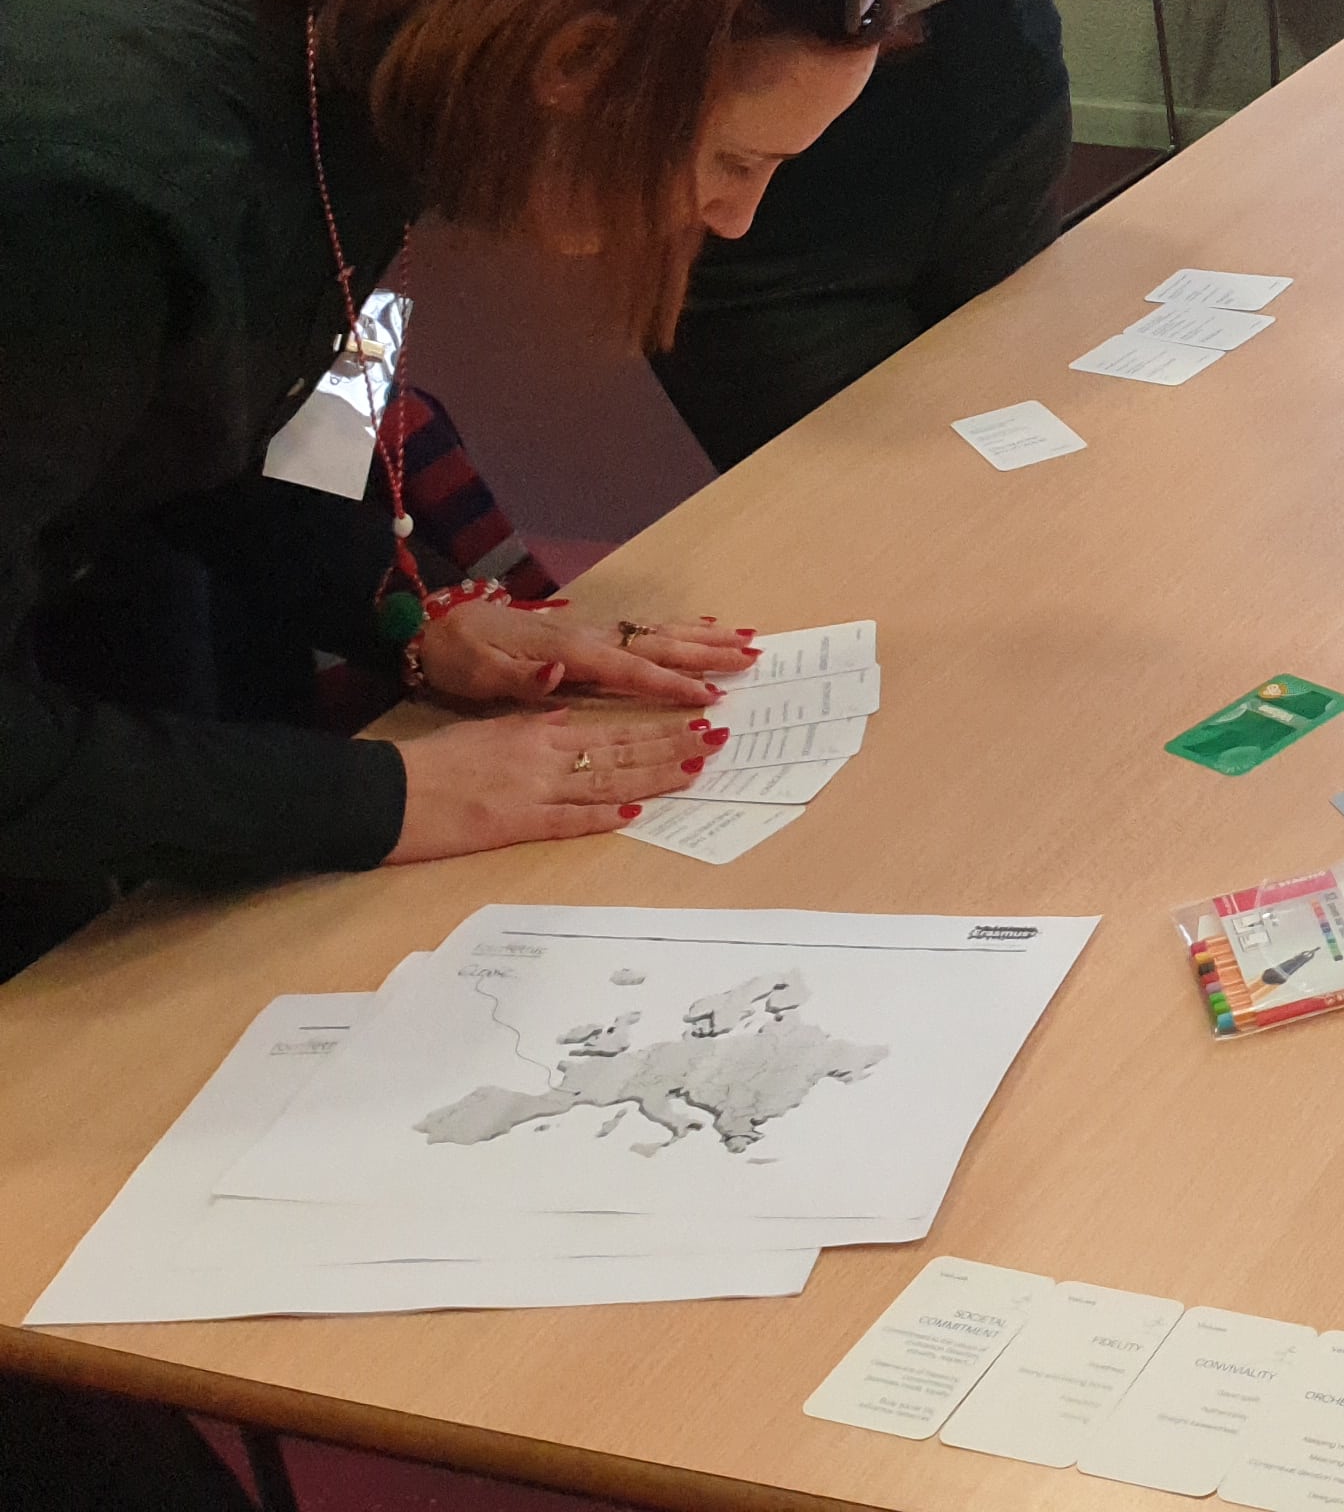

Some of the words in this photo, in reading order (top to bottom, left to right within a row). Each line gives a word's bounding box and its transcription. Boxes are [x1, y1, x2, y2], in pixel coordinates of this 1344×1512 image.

[918, 1314, 1000, 1339] COMMITMENT
[1092, 1335, 1146, 1353] FIDELITY
[1194, 1357, 1279, 1381] CONVIVIALITY
